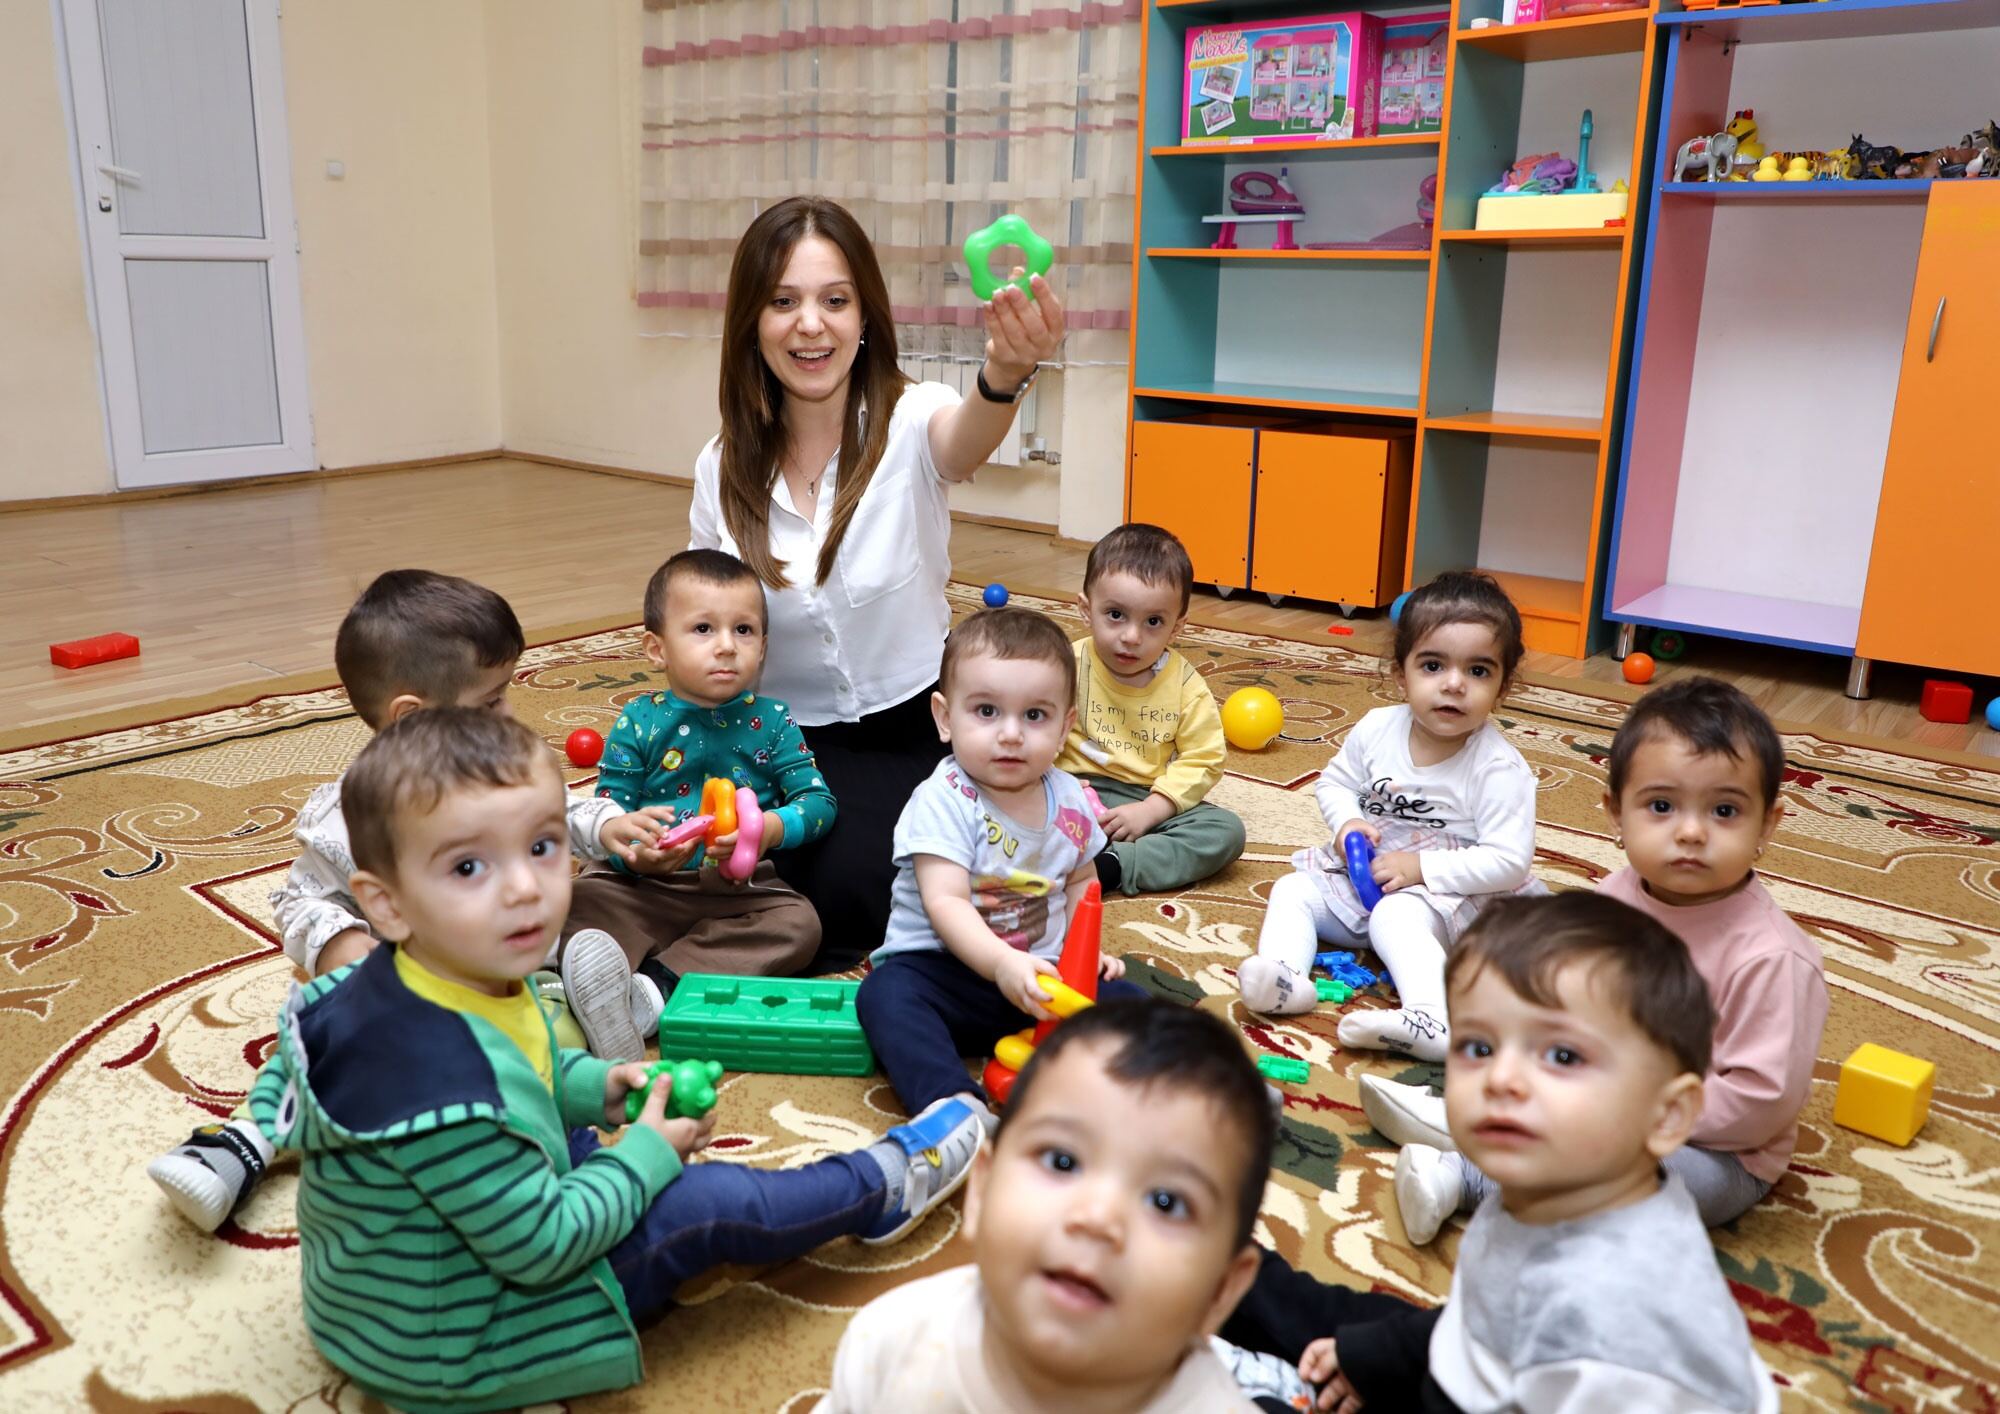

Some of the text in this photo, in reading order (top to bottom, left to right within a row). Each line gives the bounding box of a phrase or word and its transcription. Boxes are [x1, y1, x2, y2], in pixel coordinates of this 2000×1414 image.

[1091, 700, 1103, 713] Is
[1108, 706, 1126, 725] my
[1093, 718, 1171, 744] You make
